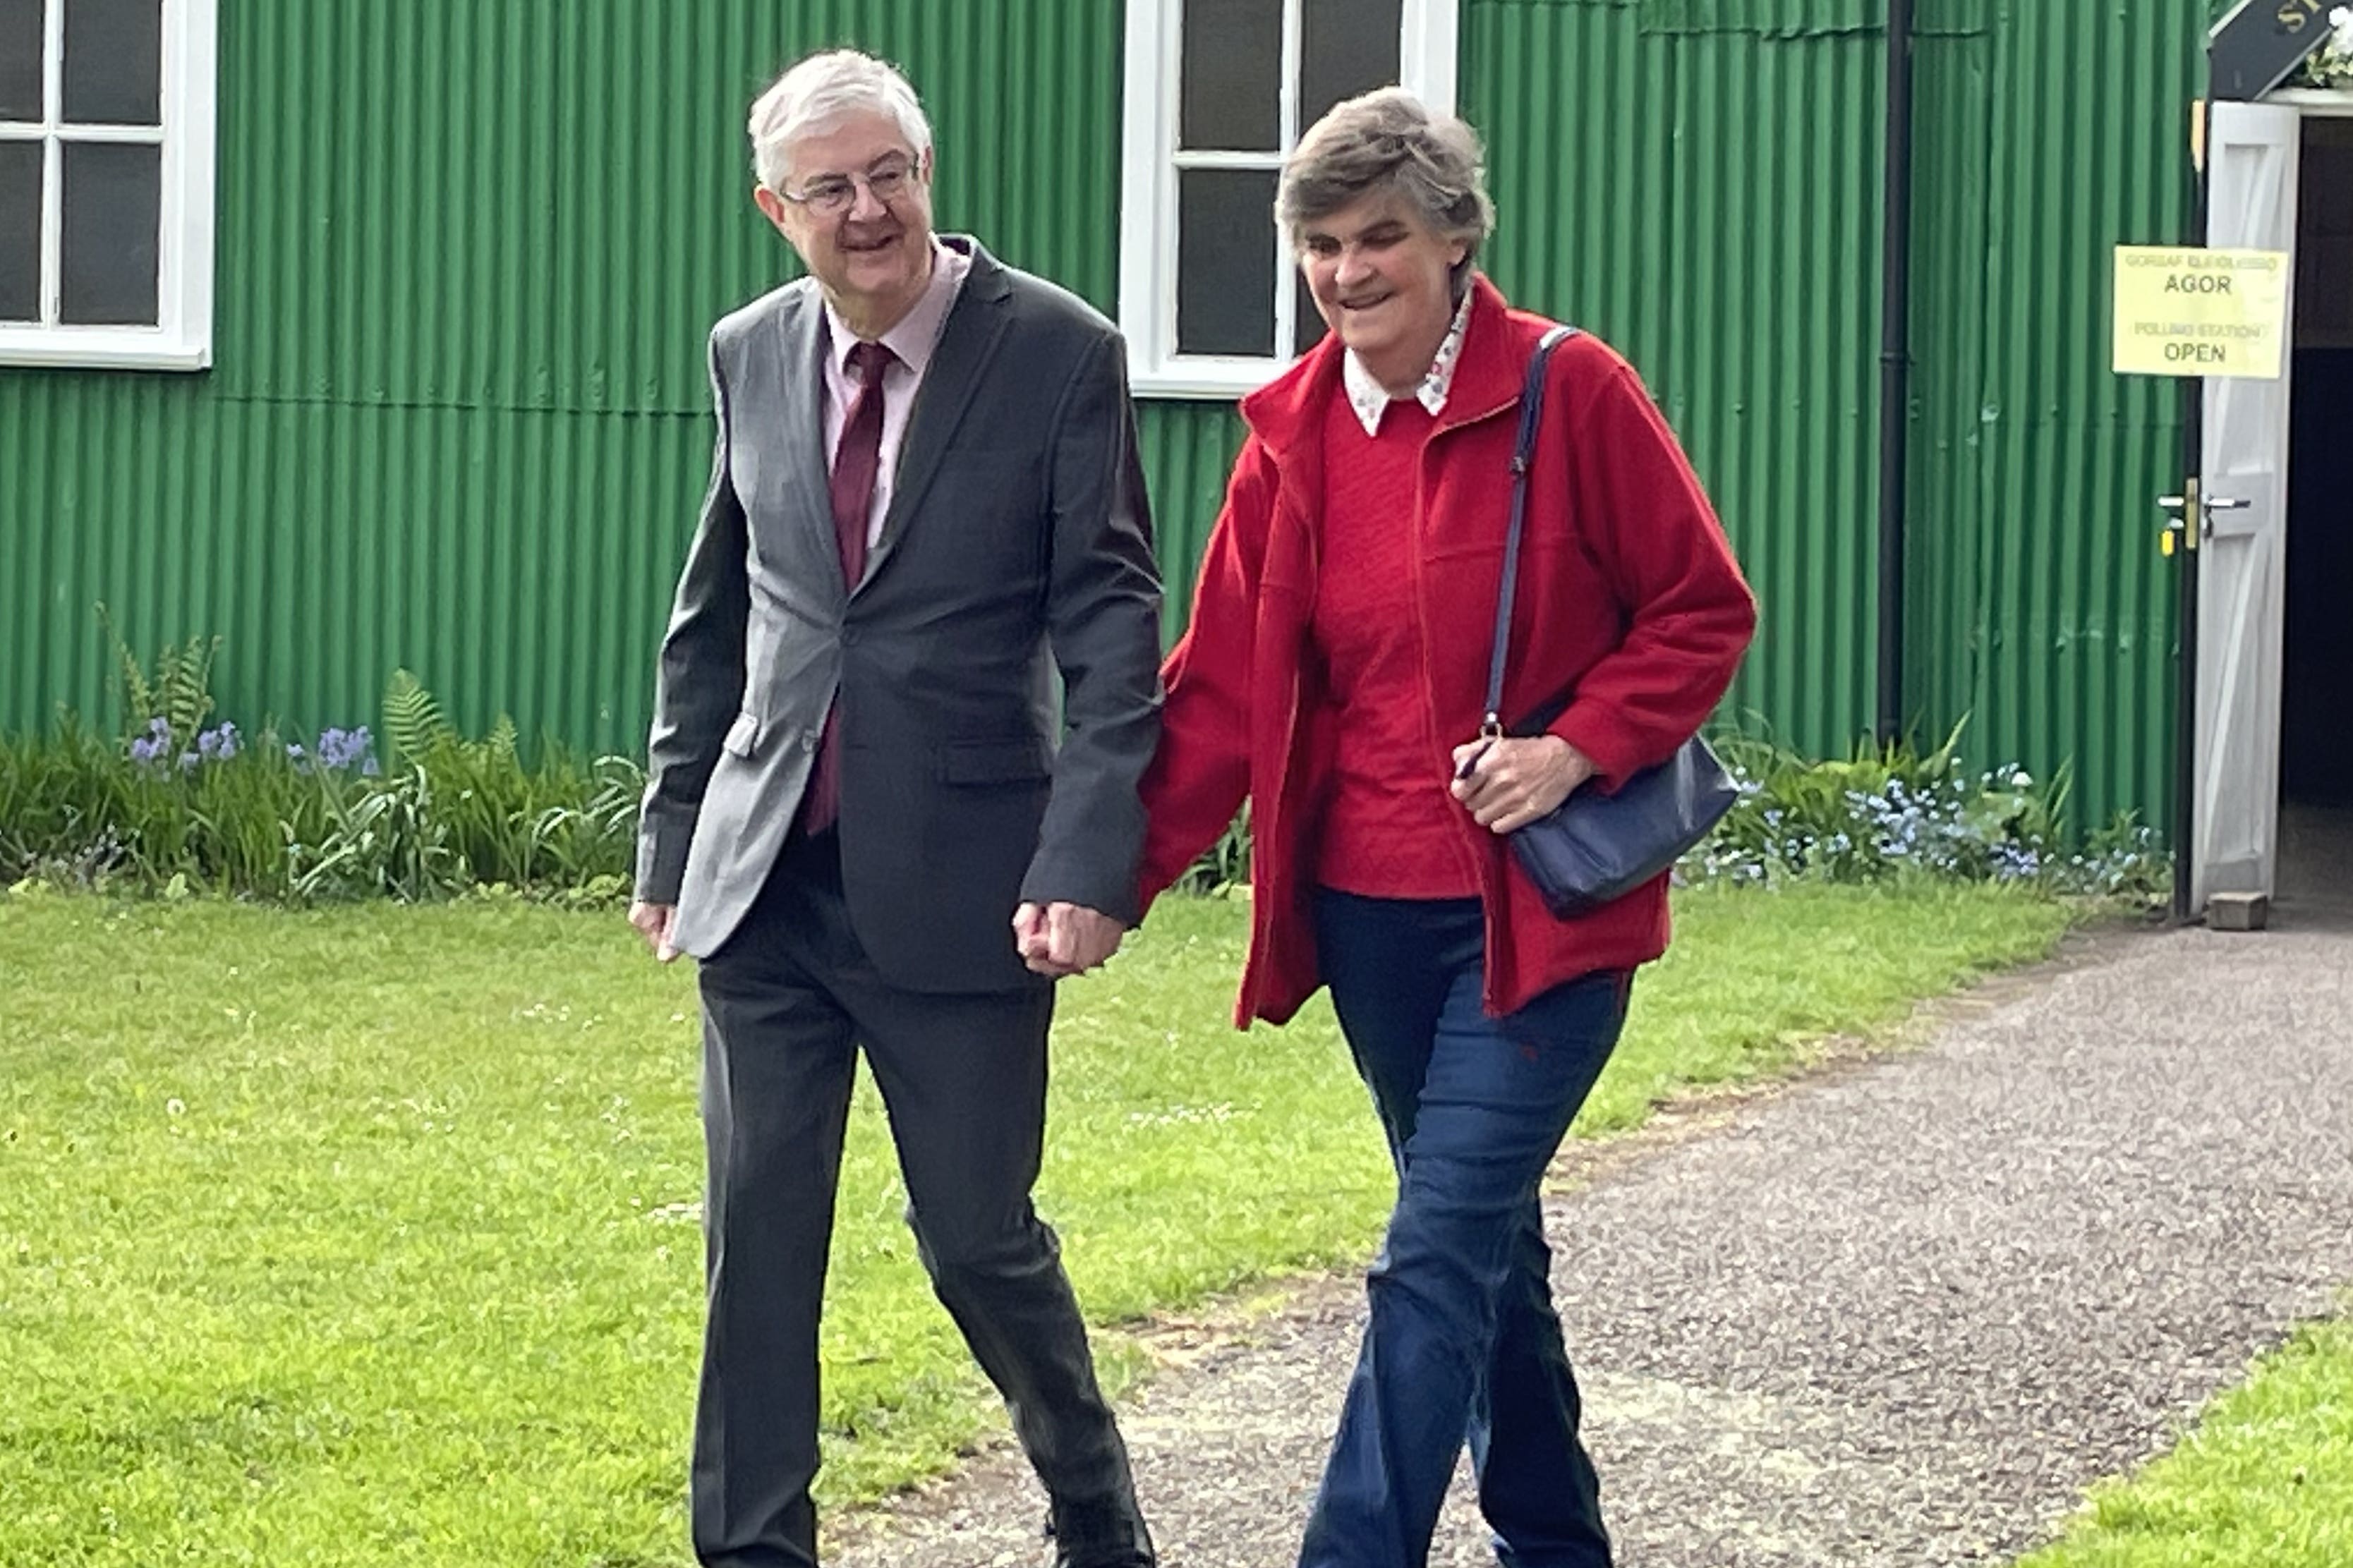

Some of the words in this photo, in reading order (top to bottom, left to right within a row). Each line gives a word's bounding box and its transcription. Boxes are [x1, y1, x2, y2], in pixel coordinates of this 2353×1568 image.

[2164, 274, 2232, 294] AGOR
[2198, 323, 2261, 339] STATION
[2164, 343, 2226, 363] OPEN
